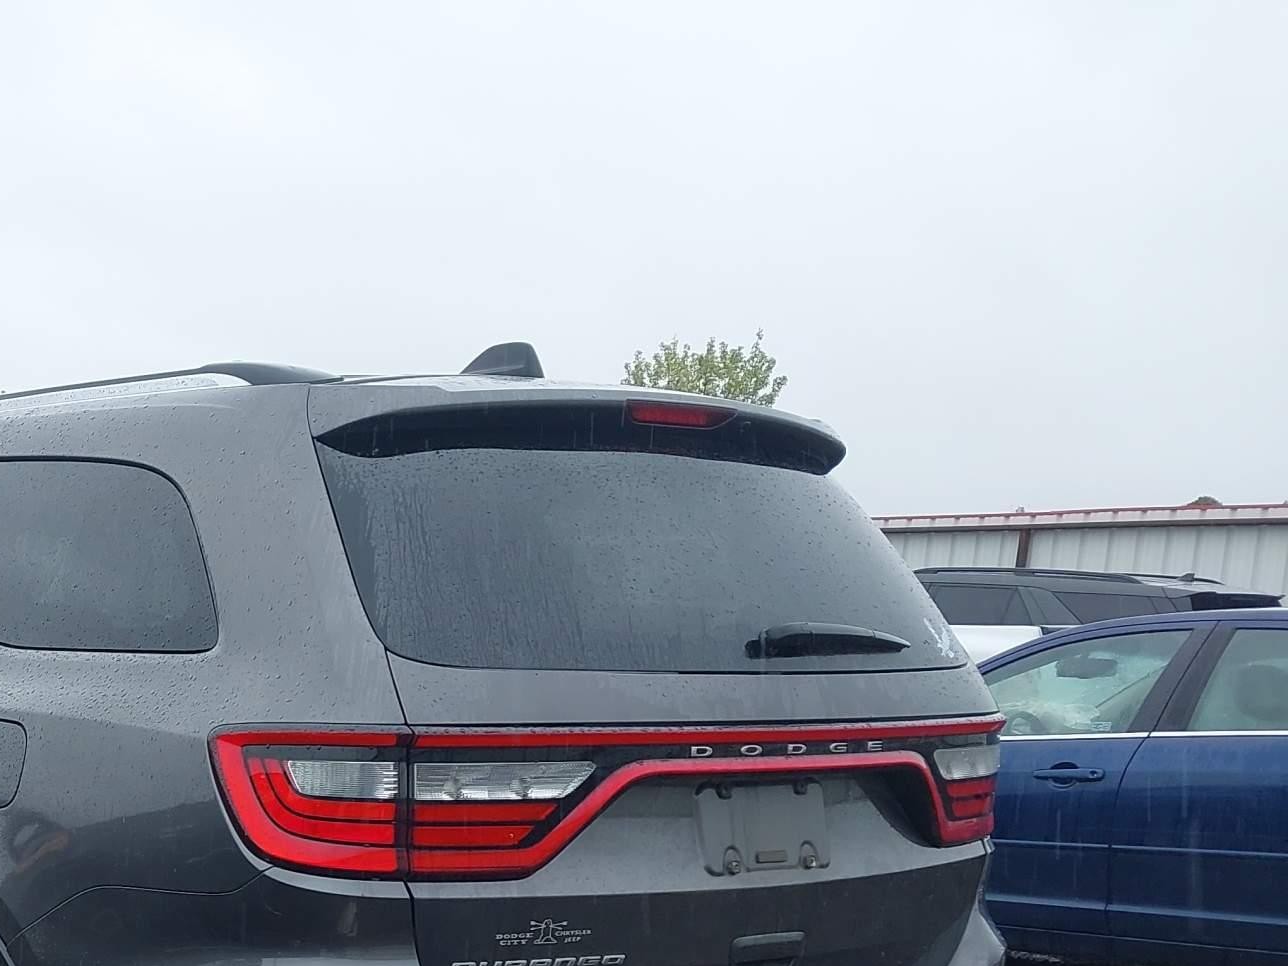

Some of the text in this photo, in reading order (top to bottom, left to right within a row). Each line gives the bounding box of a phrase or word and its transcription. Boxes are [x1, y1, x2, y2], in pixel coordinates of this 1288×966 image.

[690, 741, 883, 757] DODGE
[495, 932, 535, 940] DODGE
[563, 936, 582, 944] JEEP
